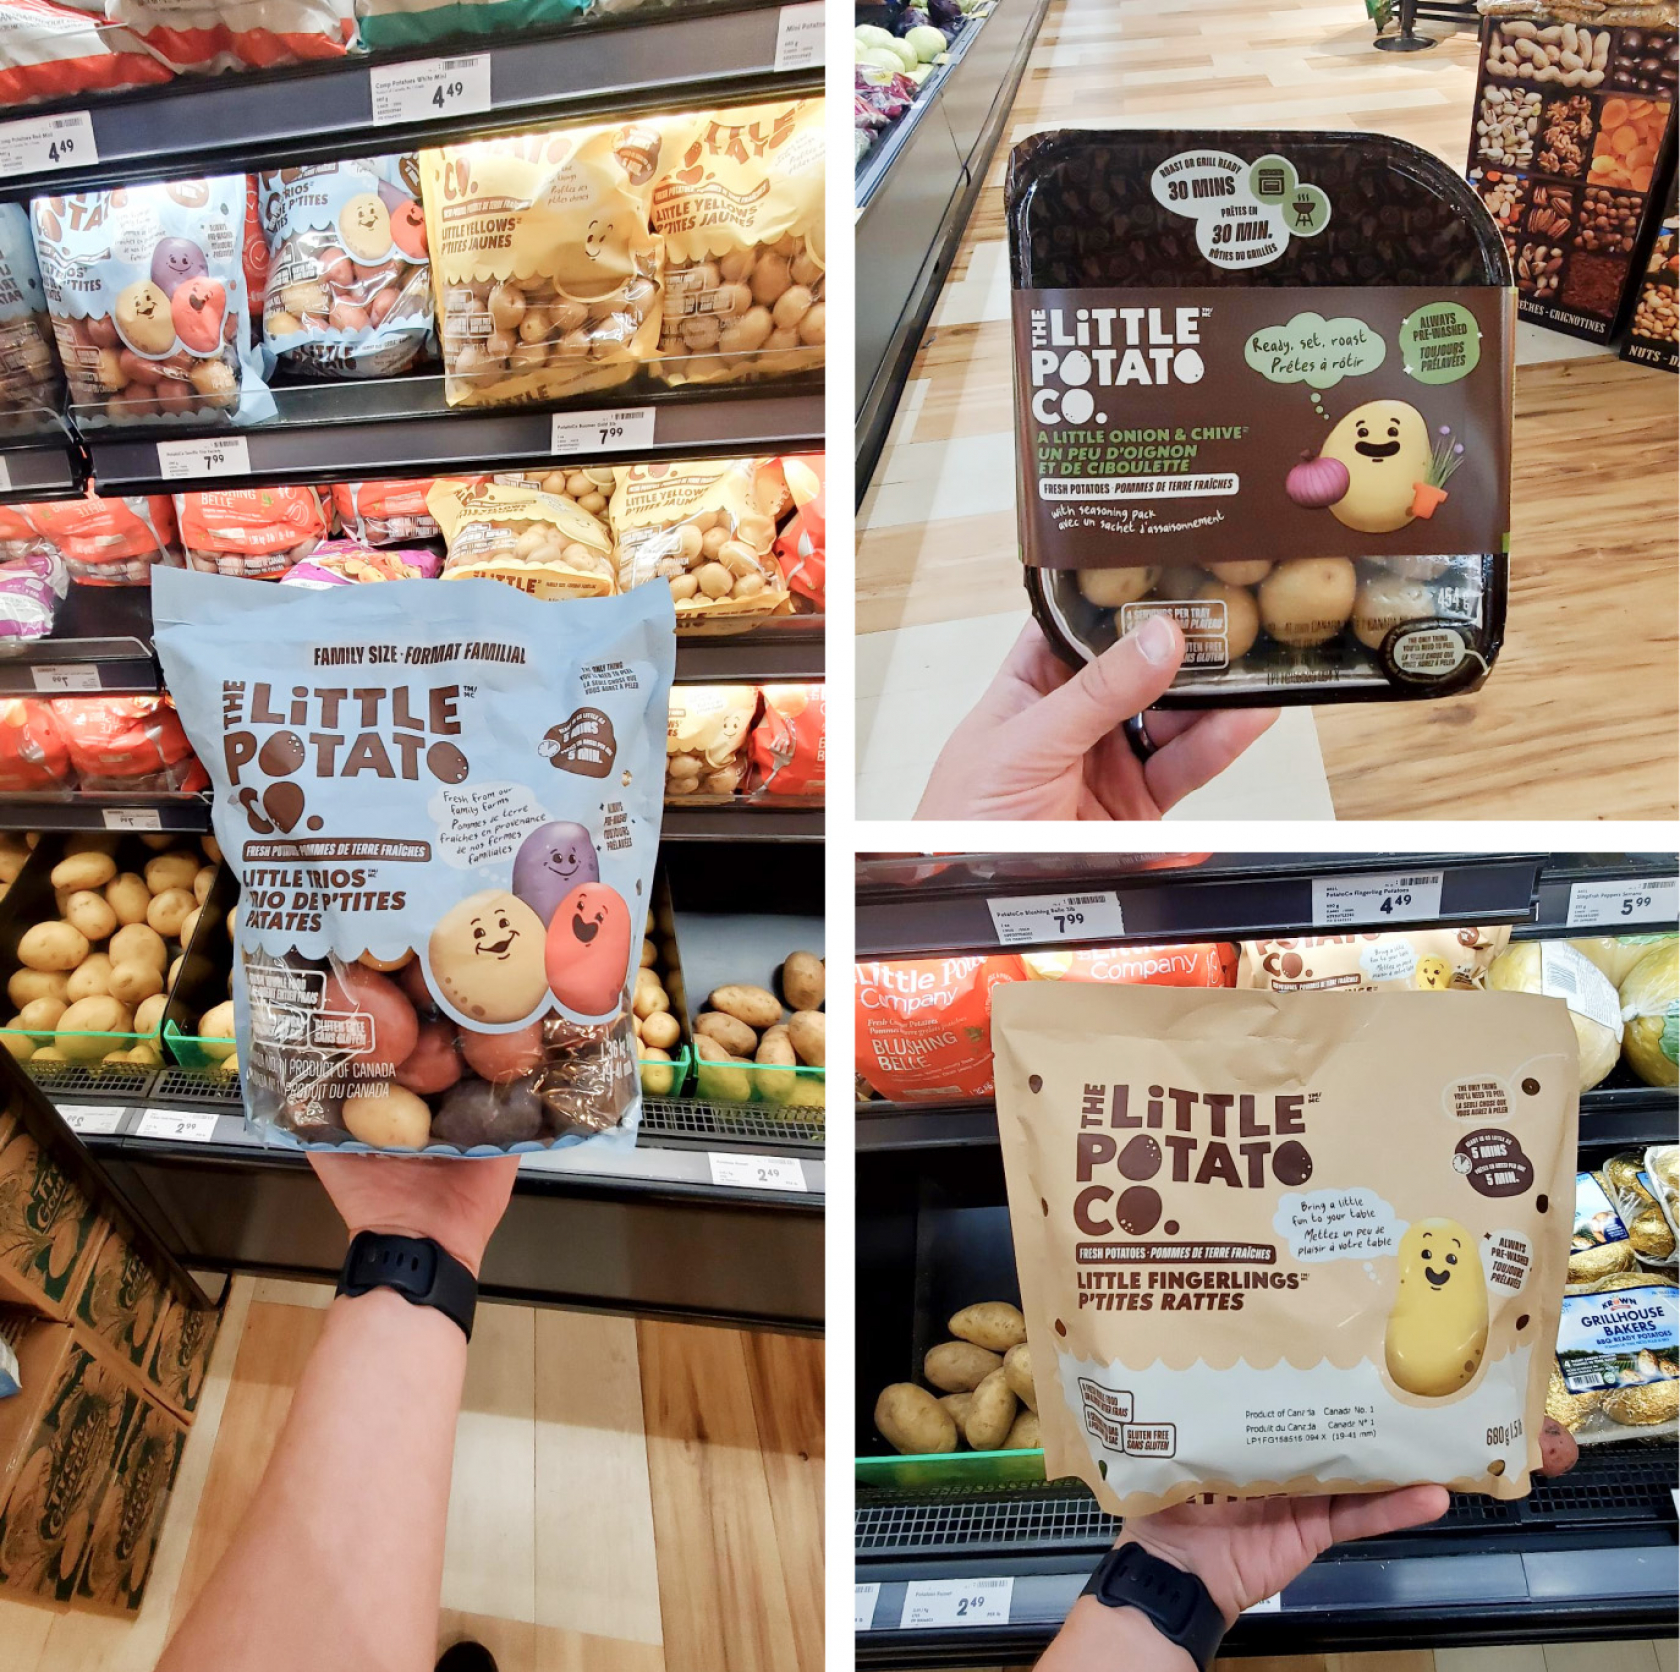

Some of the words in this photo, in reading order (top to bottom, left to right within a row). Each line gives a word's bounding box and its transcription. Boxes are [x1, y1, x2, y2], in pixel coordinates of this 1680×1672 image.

[1159, 158, 1183, 179] ROAST
[1184, 158, 1195, 167] OR
[1197, 157, 1216, 167] GRILL
[1218, 157, 1243, 175] READY
[1168, 180, 1188, 201] 30
[1192, 176, 1236, 199] MINS
[694, 198, 758, 217] YELLOWS
[1221, 205, 1247, 218] PRÊTES
[1248, 205, 1258, 215] EN
[467, 217, 516, 236] YELLOWS
[1212, 223, 1232, 244] 30
[1235, 220, 1273, 242] MIN.
[469, 235, 512, 251] JAUNES
[1208, 247, 1234, 261] RÔTIES
[1247, 242, 1278, 260] GRILLÉES
[1031, 309, 1047, 348] THE
[1420, 313, 1456, 329] ALWAYS
[1413, 323, 1468, 342] PRE-WASHED
[1252, 337, 1294, 356] Ready,
[1300, 332, 1326, 349] set,
[1331, 329, 1368, 347] roast
[1420, 342, 1465, 359] TOUJOURS
[1332, 353, 1364, 369] rôtir
[1629, 345, 1661, 362] NUTS
[1032, 348, 1204, 387] POTATO
[1421, 355, 1466, 372] PRÉLAVÉES
[1032, 388, 1108, 425] CO.
[1037, 430, 1049, 444] A
[1053, 430, 1105, 444] LITTLE
[1109, 428, 1170, 443] ONION
[1174, 428, 1187, 441] &
[1191, 426, 1242, 441] CHIVE
[1038, 447, 1064, 461] UN
[1068, 447, 1101, 461] PEU
[1106, 445, 1198, 460] D'OIGNON
[1039, 461, 1058, 475] ET
[1060, 461, 1082, 475] DE
[1087, 459, 1191, 475] CIBOULETTE
[1044, 484, 1068, 495] FRESH
[1070, 483, 1110, 495] POTATOES
[1114, 482, 1154, 494] POMMES
[1155, 482, 1166, 493] DE
[1168, 480, 1191, 492] TERRE
[1193, 478, 1233, 491] FRAÎCHES
[1051, 504, 1075, 519] with
[1079, 505, 1128, 522] seasoning
[1131, 510, 1157, 521] pack
[1058, 519, 1080, 531] avec
[1083, 519, 1095, 527] un
[1100, 519, 1135, 533] sachet
[1139, 510, 1225, 534] d'assaisonnement
[1437, 587, 1460, 608] 454
[314, 646, 364, 666] FAMILY
[369, 645, 397, 663] SIZE
[404, 643, 461, 665] FORMAT
[464, 642, 526, 664] FAMILIAL
[223, 680, 246, 730] THE
[224, 730, 469, 786] POTATO
[443, 791, 468, 803] Fresh
[472, 792, 495, 803] from
[451, 804, 478, 816] family
[482, 797, 509, 811] farms
[481, 829, 491, 837] en
[495, 813, 546, 834] provenance
[489, 831, 522, 846] fermes
[246, 845, 270, 857] FRESH
[337, 844, 349, 856] DE
[351, 843, 379, 856] TERRE
[468, 845, 512, 865] familiales
[243, 869, 302, 888] LITTLE
[307, 869, 366, 888] TRIOS
[292, 892, 319, 910] DE
[322, 891, 406, 911] P'TITES
[245, 910, 322, 932] PATATES
[1090, 953, 1198, 982] Company
[1263, 952, 1313, 979] CO.
[872, 1031, 958, 1055] BLUSHING
[353, 1062, 396, 1079] CANADA
[878, 1056, 932, 1071] BELLE
[329, 1082, 345, 1099] DU
[347, 1082, 390, 1099] CANADA
[1081, 1083, 1106, 1129] THE
[1077, 1133, 1313, 1188] POTATO
[1471, 1146, 1480, 1159] 5
[1479, 1144, 1508, 1158] MINS
[1485, 1173, 1494, 1186] 5
[1073, 1185, 1180, 1237] CO.
[1301, 1201, 1326, 1213] Bring
[1339, 1196, 1364, 1208] little
[1292, 1215, 1308, 1227] fun
[1311, 1213, 1322, 1223] to
[1327, 1213, 1345, 1225] your
[1350, 1208, 1376, 1218] table
[1304, 1228, 1339, 1243] Mettez
[1356, 1228, 1372, 1238] peu
[1375, 1226, 1385, 1235] de
[1079, 1247, 1102, 1259] FRESH
[1105, 1247, 1145, 1259] POTATOES
[1150, 1247, 1190, 1259] POMMES
[1192, 1247, 1203, 1259] DE
[1205, 1247, 1230, 1259] TERRE
[1230, 1245, 1271, 1260] FRAÎCHES
[1298, 1245, 1325, 1257] plaisir
[1338, 1239, 1363, 1251] votre
[1367, 1237, 1392, 1247] table
[1499, 1237, 1527, 1254] ALWAYS
[1491, 1247, 1529, 1267] PRE-WASHED
[1077, 1271, 1141, 1290] LITTLE
[1148, 1271, 1299, 1290] FINGERLINGS
[1078, 1292, 1153, 1311] P'TITES
[1161, 1293, 1245, 1311] RATTES
[1581, 1306, 1665, 1328] GRILLHOUSE
[1603, 1320, 1657, 1337] BAKERS
[1638, 1330, 1672, 1340] POTATOES
[1277, 1409, 1285, 1417] of
[1127, 1430, 1152, 1440] GLUTEN
[1153, 1430, 1169, 1440] FREE
[1275, 1424, 1286, 1432] du
[1486, 1425, 1505, 1446] 680
[1127, 1440, 1143, 1450] SANS
[1144, 1441, 1169, 1450] GLUTEN
